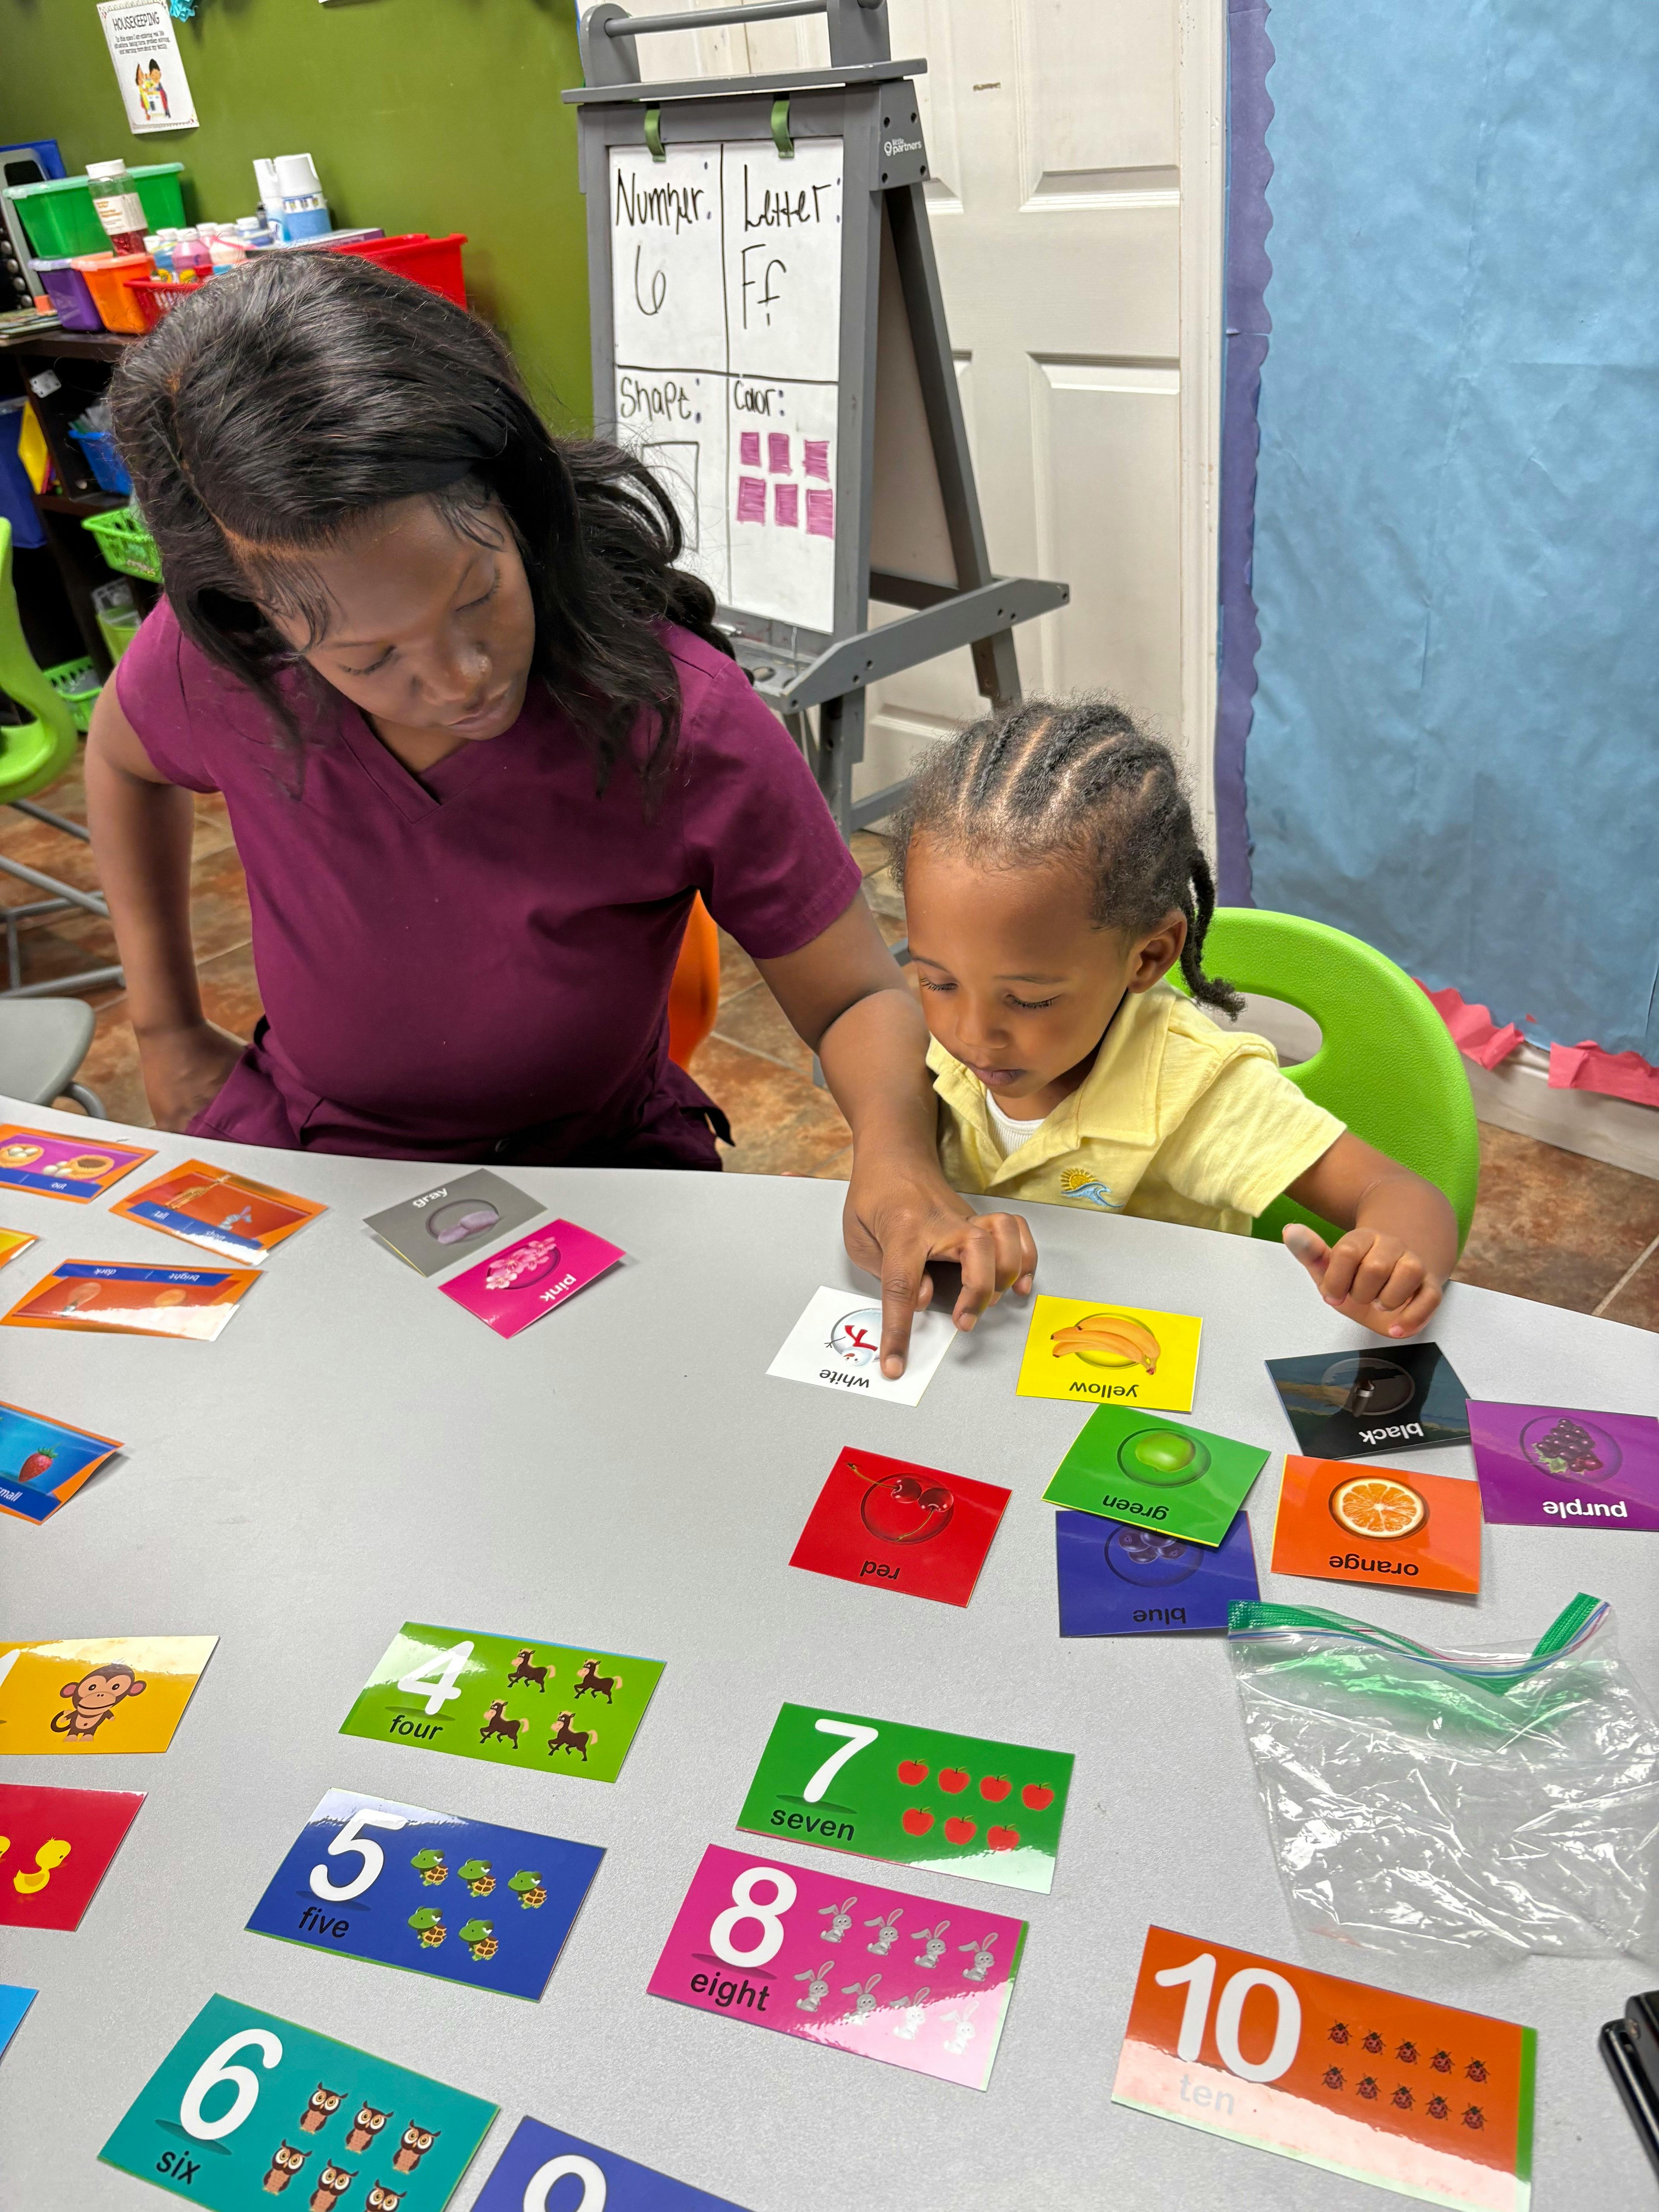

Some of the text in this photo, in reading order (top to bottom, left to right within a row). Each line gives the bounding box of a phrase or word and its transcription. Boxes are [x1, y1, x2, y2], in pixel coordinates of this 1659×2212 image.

[112, 12, 160, 31] HOUSEKEEPING
[893, 141, 922, 155] partners
[635, 244, 666, 315] 6
[412, 1188, 448, 1208] gray
[94, 1268, 200, 1282] bright dark
[539, 1273, 577, 1302] pink
[819, 1369, 869, 1389] white
[1069, 1381, 1139, 1398] yellow
[1358, 1422, 1424, 1445] black
[0, 1487, 23, 1502] mall
[1103, 1494, 1170, 1520] green
[1542, 1499, 1628, 1519] purple
[860, 1560, 900, 1580] red
[1329, 1554, 1419, 1576] orange
[1133, 1607, 1186, 1625] blue
[398, 1640, 475, 1715] 4
[388, 1714, 443, 1741] four
[815, 1718, 879, 1803] 7
[770, 1808, 855, 1841] seven
[310, 1808, 408, 1902] 5
[298, 1906, 350, 1938] five
[709, 1867, 797, 1968] 8
[690, 1971, 770, 2012] eight
[1155, 1953, 1302, 2082] 10
[180, 2028, 283, 2140] 6
[1180, 2073, 1235, 2115] ten
[156, 2150, 201, 2185] six
